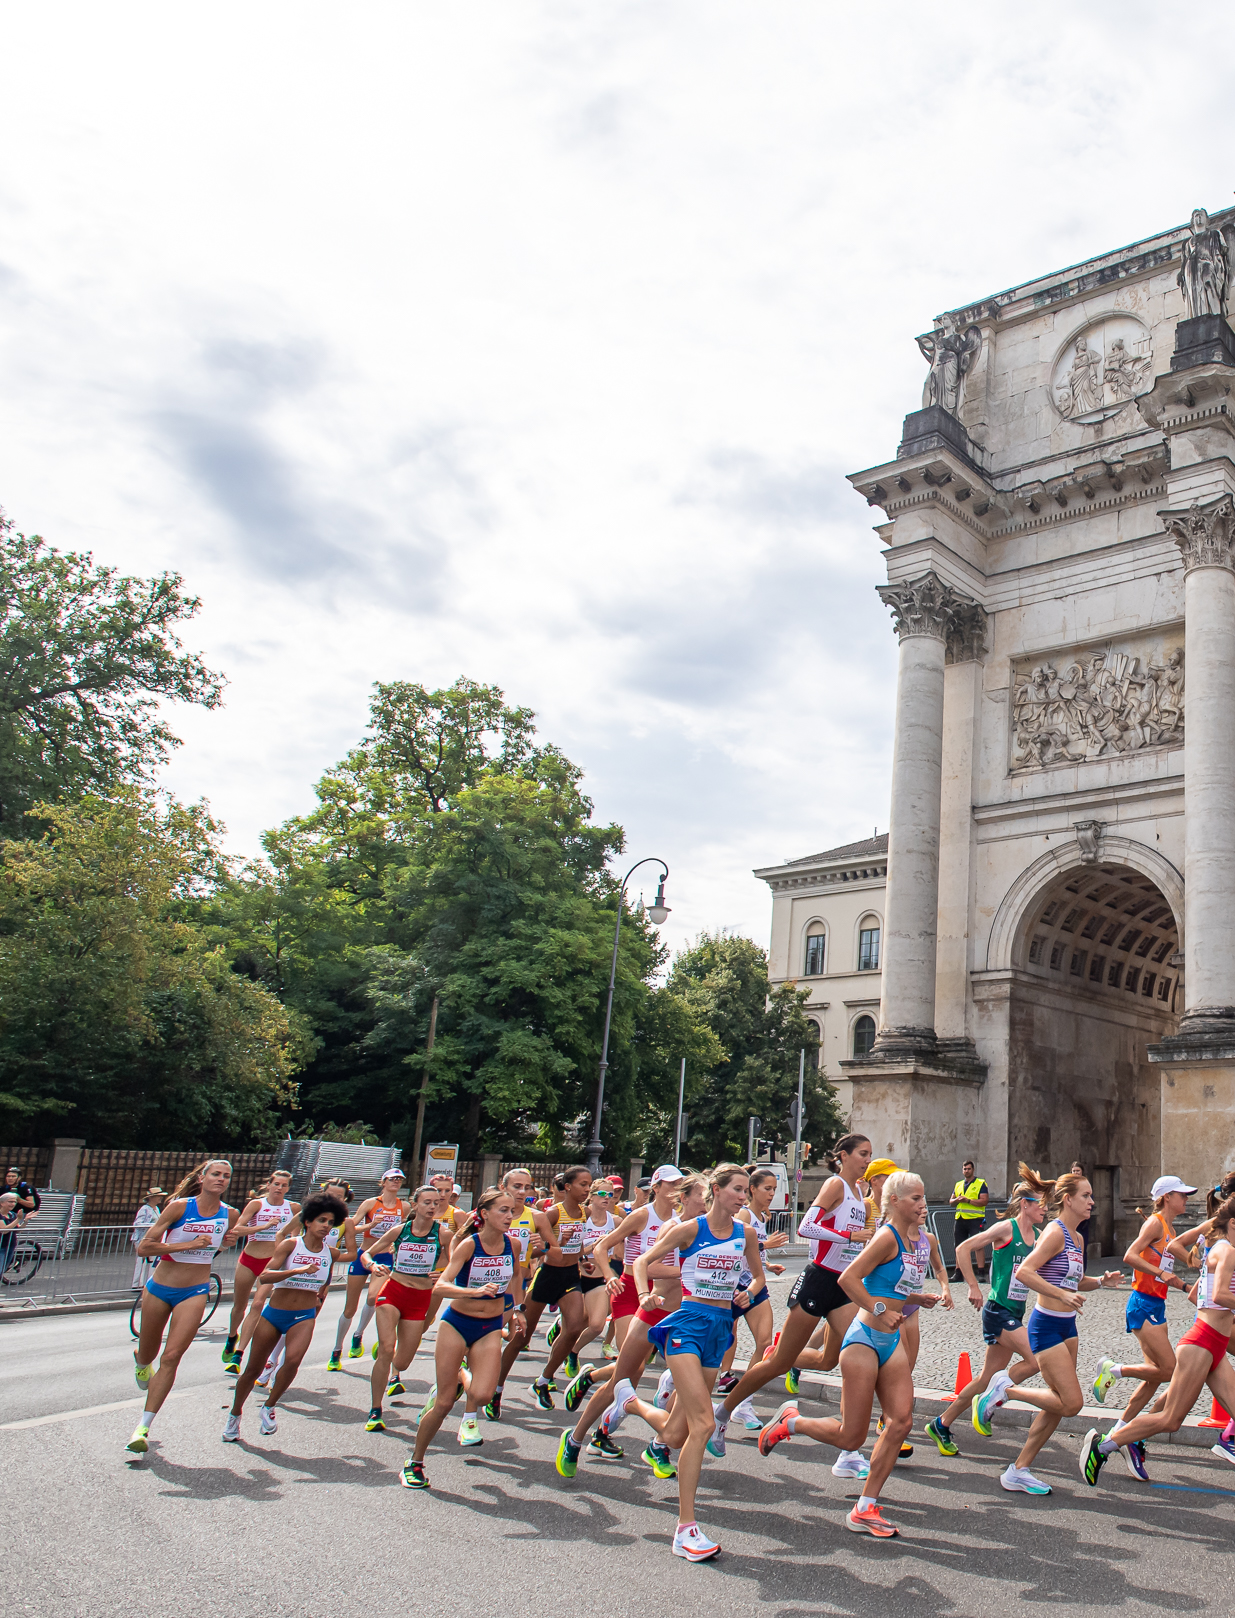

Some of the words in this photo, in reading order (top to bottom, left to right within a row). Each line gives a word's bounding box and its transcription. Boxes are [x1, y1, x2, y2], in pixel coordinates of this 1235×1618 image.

[184, 1224, 213, 1233] SPAR
[401, 1244, 427, 1252] SPAR
[294, 1257, 320, 1265] SPAR
[474, 1258, 503, 1266] SPAR
[699, 1259, 733, 1269] SPAR
[711, 1271, 727, 1280] 412
[791, 1271, 806, 1299] SUISSE
[696, 1289, 720, 1297] MUNICH
